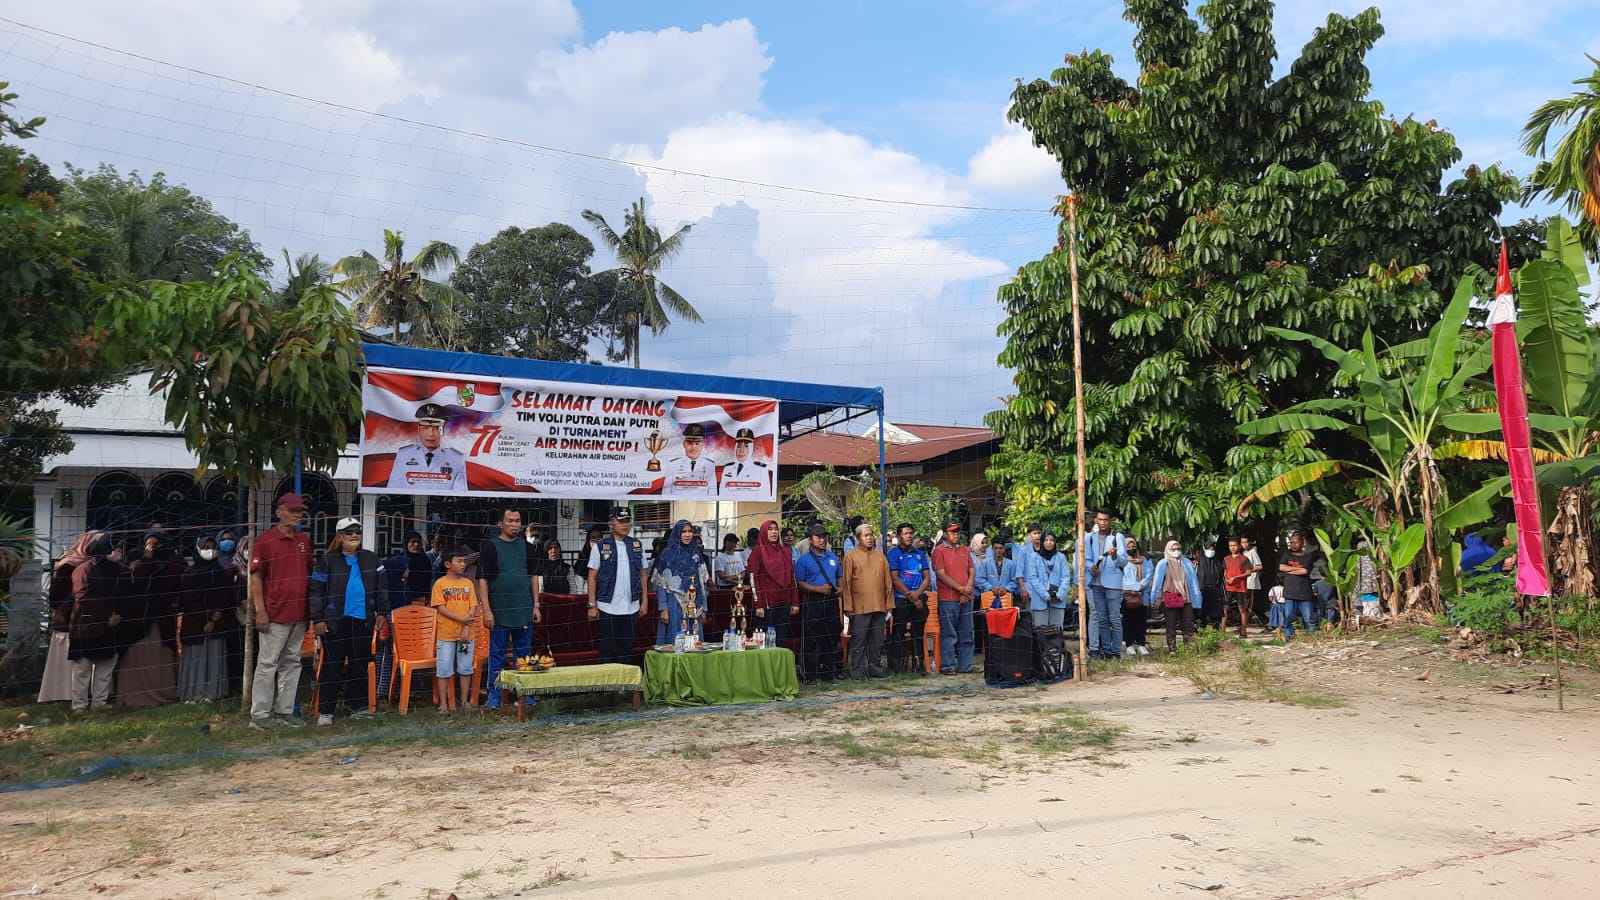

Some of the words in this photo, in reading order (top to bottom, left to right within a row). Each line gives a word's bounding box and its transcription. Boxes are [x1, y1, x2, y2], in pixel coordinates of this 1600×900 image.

[511, 390, 595, 411] SELAMAT
[602, 397, 666, 417] DATANG
[517, 411, 536, 423] TIM
[538, 413, 563, 424] VOLI
[565, 415, 599, 426] PUTRA
[602, 417, 625, 428] DAN
[630, 419, 659, 429] PUTRI
[469, 424, 504, 457] 77
[549, 427, 561, 435] DI
[563, 427, 627, 439] TURNAMENT
[534, 436, 558, 449] AIR
[560, 438, 604, 451] DINGIN
[607, 441, 632, 451] CUP
[545, 452, 588, 461] KELURAHAN
[590, 453, 602, 461] AIR
